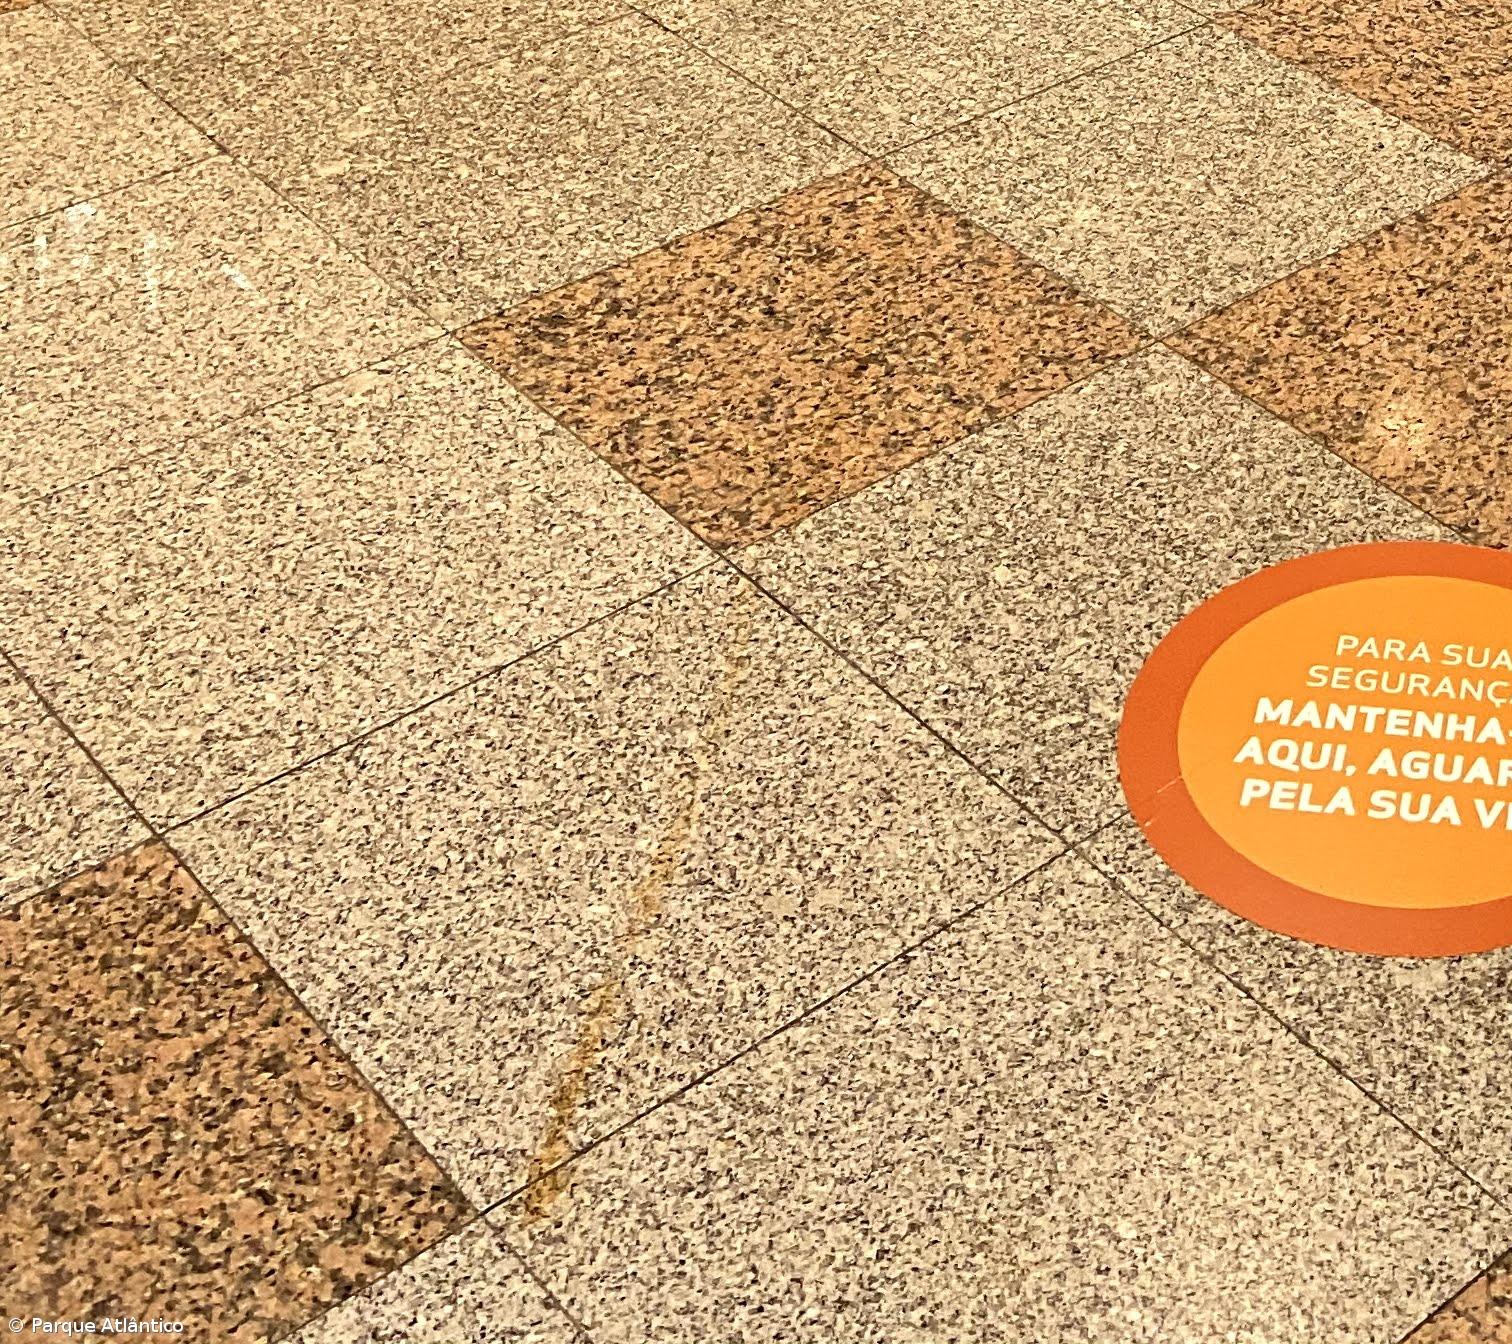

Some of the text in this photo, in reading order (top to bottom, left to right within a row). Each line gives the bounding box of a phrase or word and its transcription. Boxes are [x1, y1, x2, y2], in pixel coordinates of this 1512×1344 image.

[1335, 634, 1432, 664] PARA
[1232, 736, 1357, 777] AQUI,
[1239, 778, 1357, 817] PELA
[1367, 789, 1462, 827] SUA
